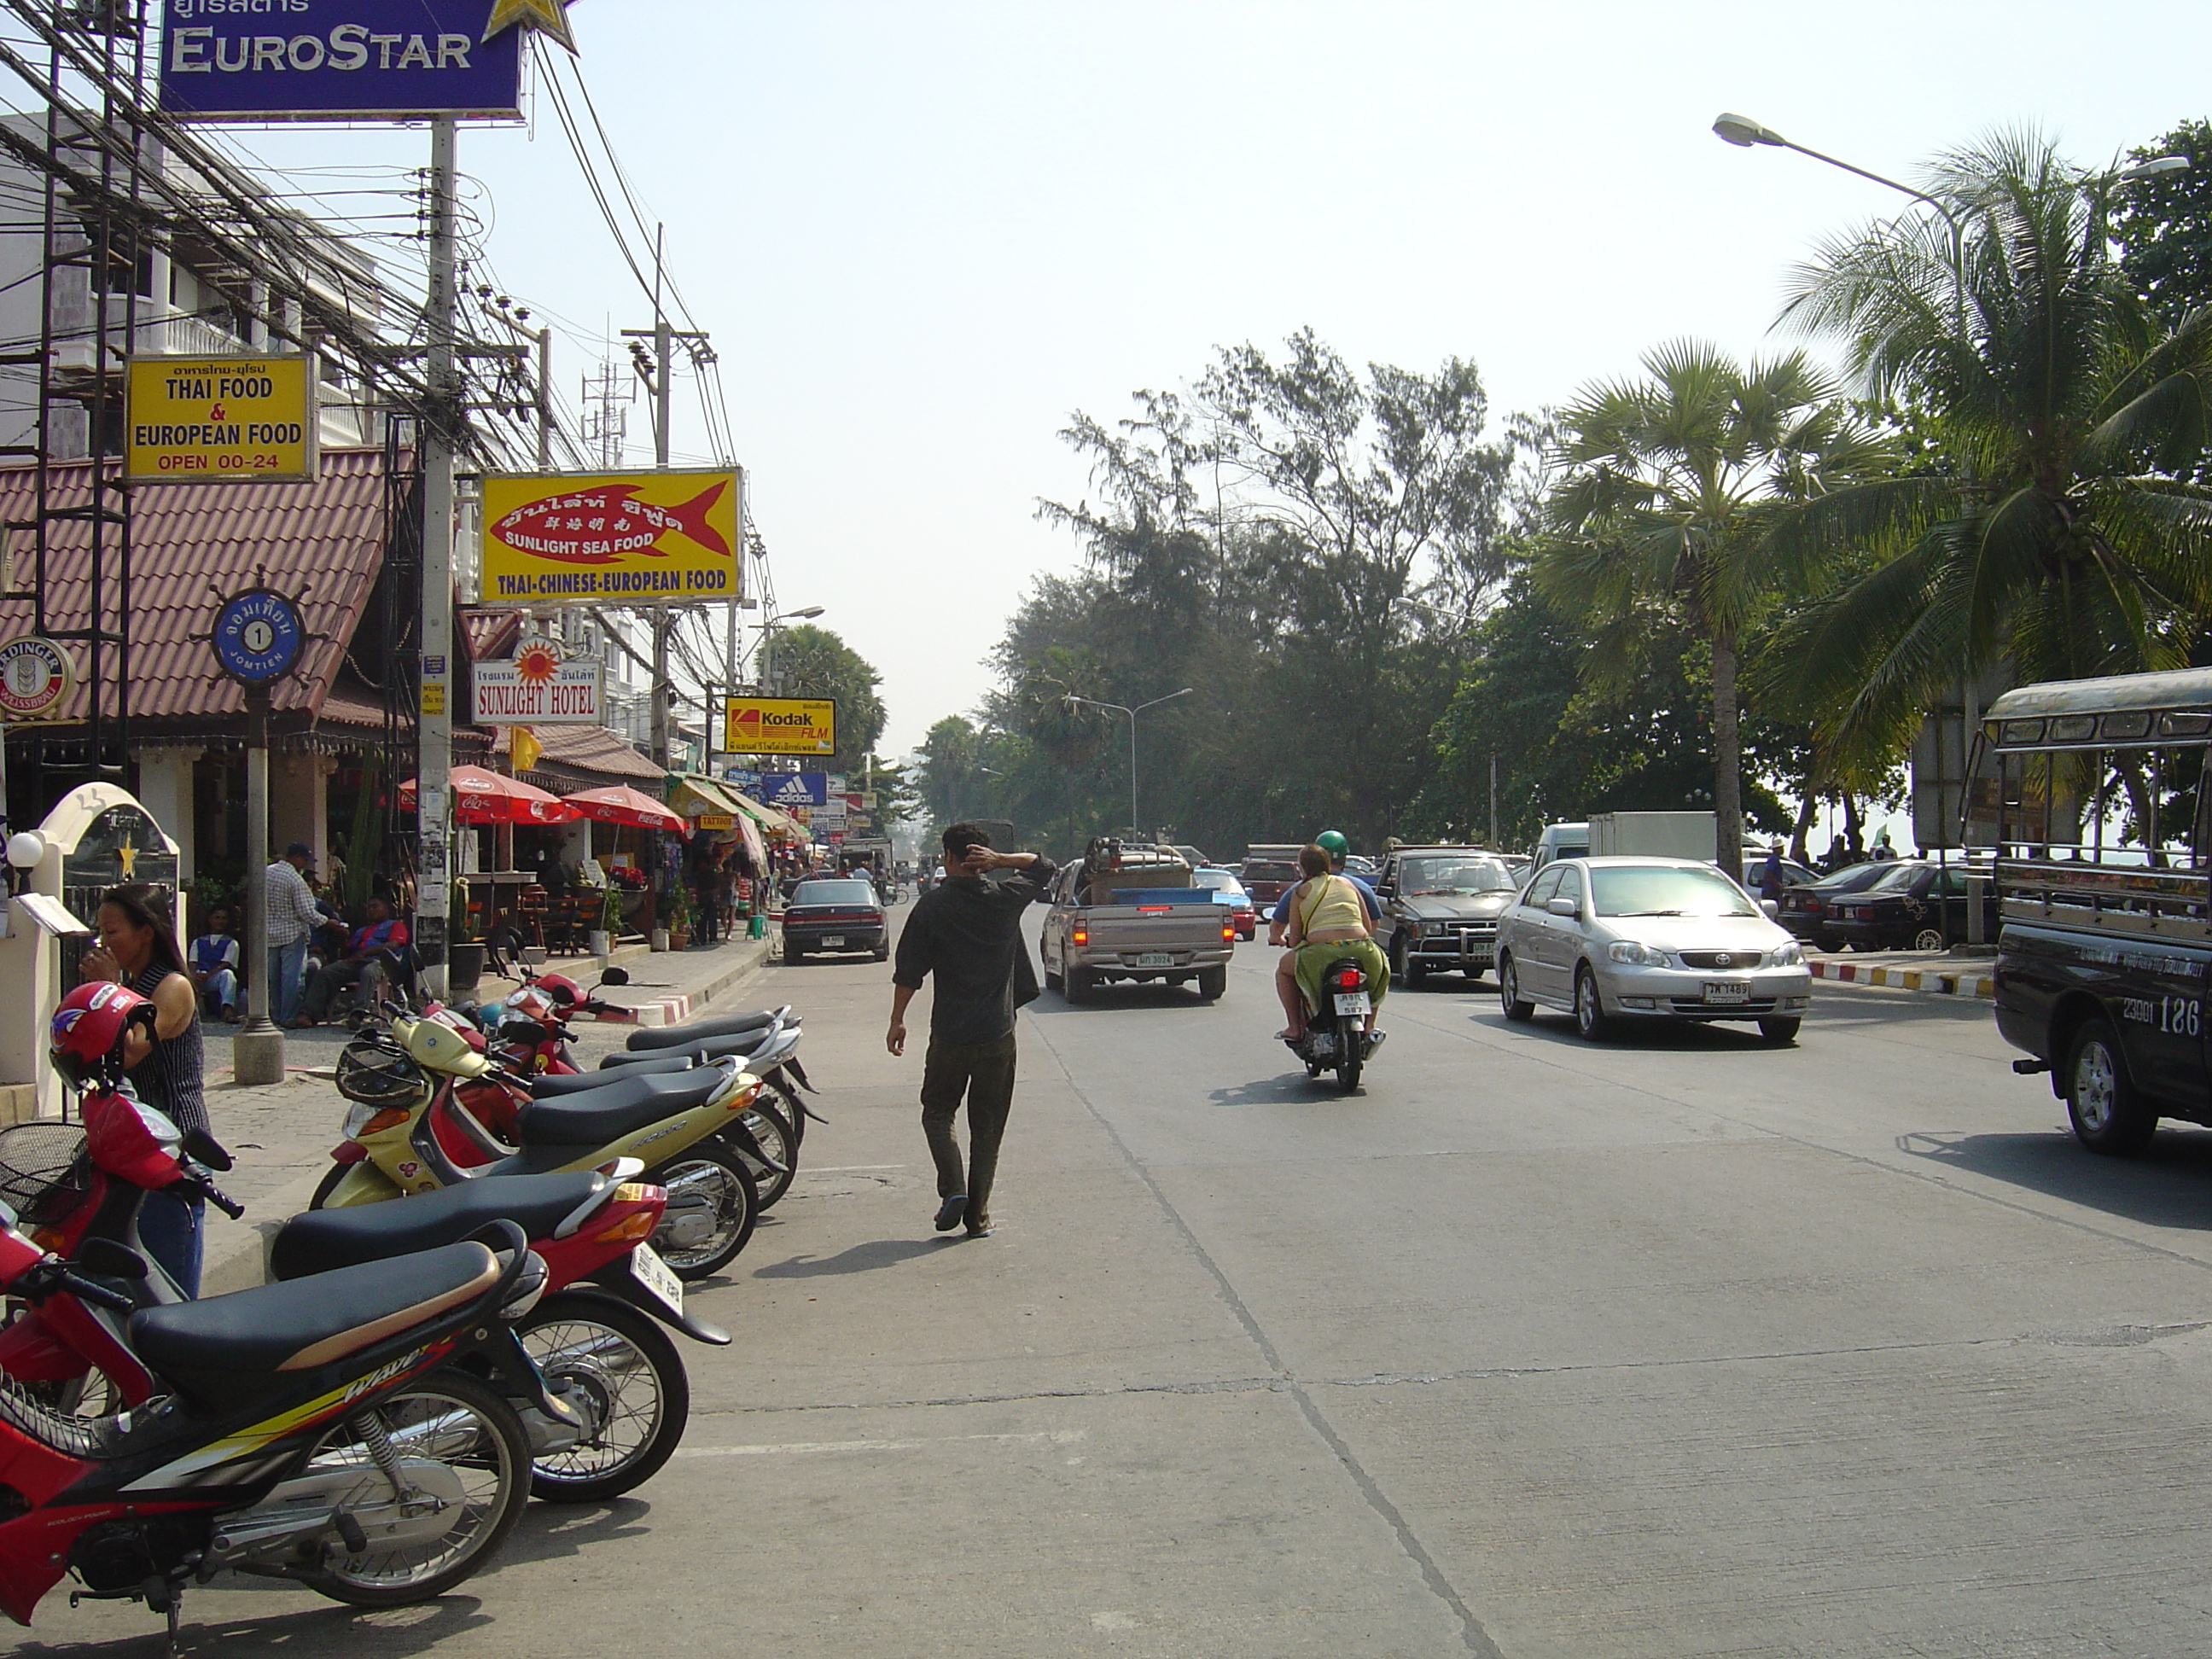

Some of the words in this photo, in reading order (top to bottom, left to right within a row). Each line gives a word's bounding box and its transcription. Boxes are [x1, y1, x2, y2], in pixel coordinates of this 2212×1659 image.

[166, 378, 212, 399] THAI
[219, 377, 273, 399] FOOD
[210, 403, 225, 421] &
[135, 424, 240, 446] EUROPEAN
[248, 423, 302, 445] FOOD
[158, 455, 207, 469] OPEN
[218, 454, 278, 469] 00-24
[505, 531, 579, 555] SUNLIGHT
[581, 541, 611, 555] SEA
[614, 532, 654, 552] FOOD
[497, 570, 681, 595] THAI-CHINESE-EUROPEAN
[686, 569, 726, 590] FOOD
[254, 627, 261, 644] 1
[230, 652, 283, 670] JOMTIEN
[479, 685, 544, 715] SUNLIGHT
[550, 685, 596, 714] HOTEL
[762, 713, 812, 725] Kodak
[800, 728, 828, 739] FILM
[776, 793, 813, 803] adidas
[2123, 997, 2153, 1024] 23001
